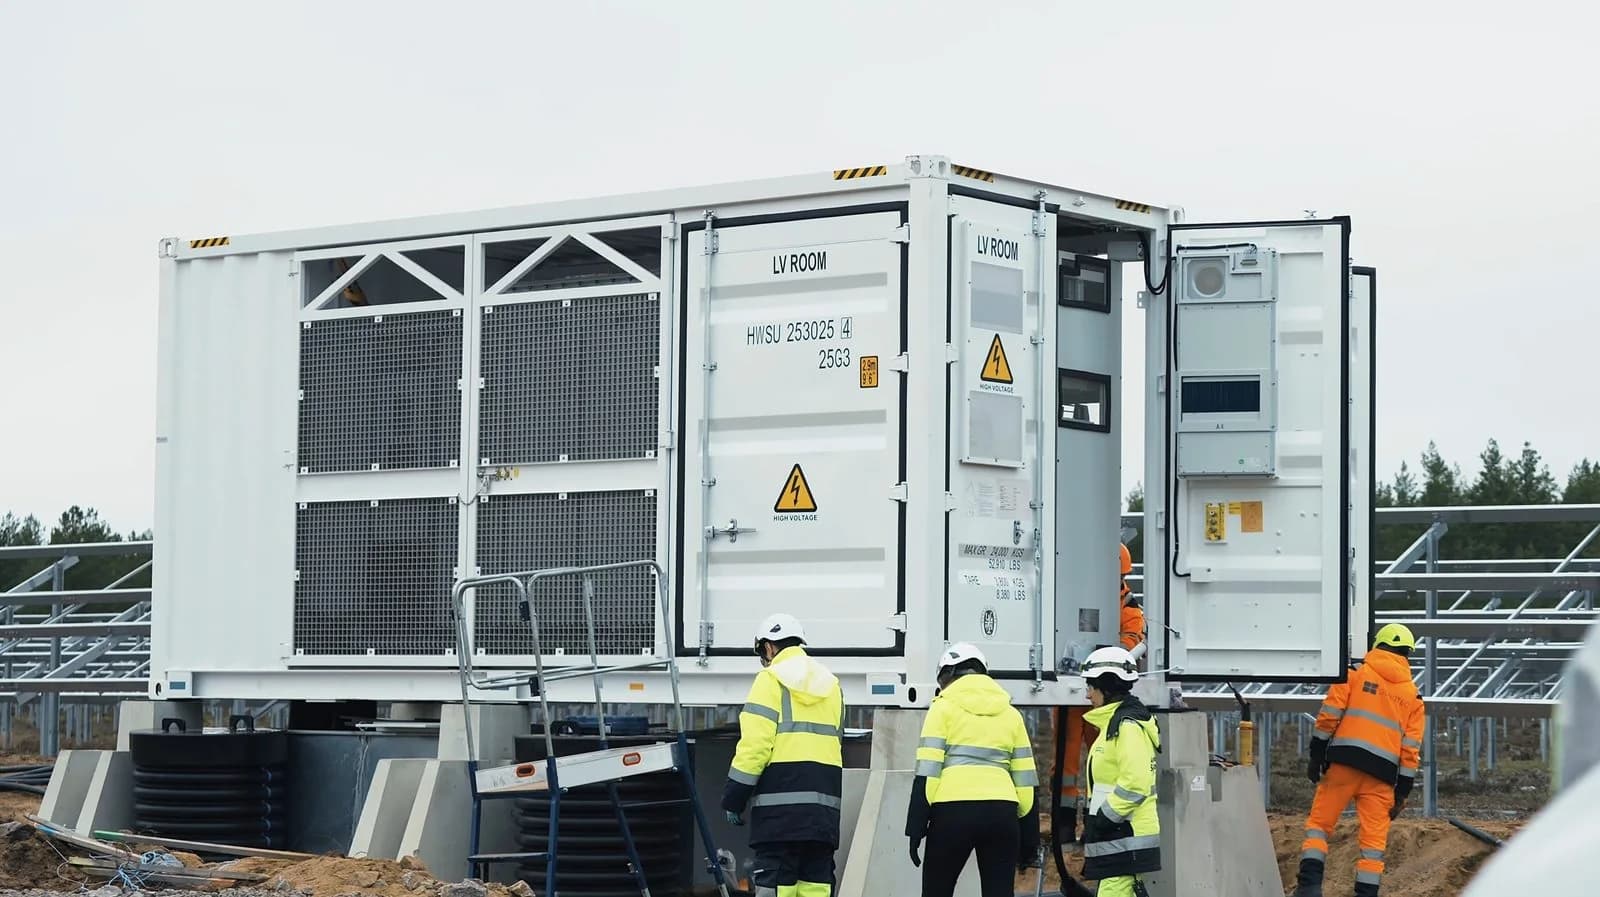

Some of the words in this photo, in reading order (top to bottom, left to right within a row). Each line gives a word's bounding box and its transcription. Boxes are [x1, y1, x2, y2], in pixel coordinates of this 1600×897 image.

[978, 235, 989, 254] LV
[991, 237, 1018, 261] ROOM
[773, 254, 787, 274] LV
[790, 251, 827, 273] ROOM
[747, 324, 781, 345] HWSU
[787, 319, 835, 342] 253025
[842, 318, 850, 338] 4
[818, 347, 851, 369] 25G3
[980, 383, 991, 391] HIGH
[992, 385, 1014, 394] VOLTAGE
[1009, 559, 1021, 571] LBS
[1014, 590, 1026, 601] LBS
